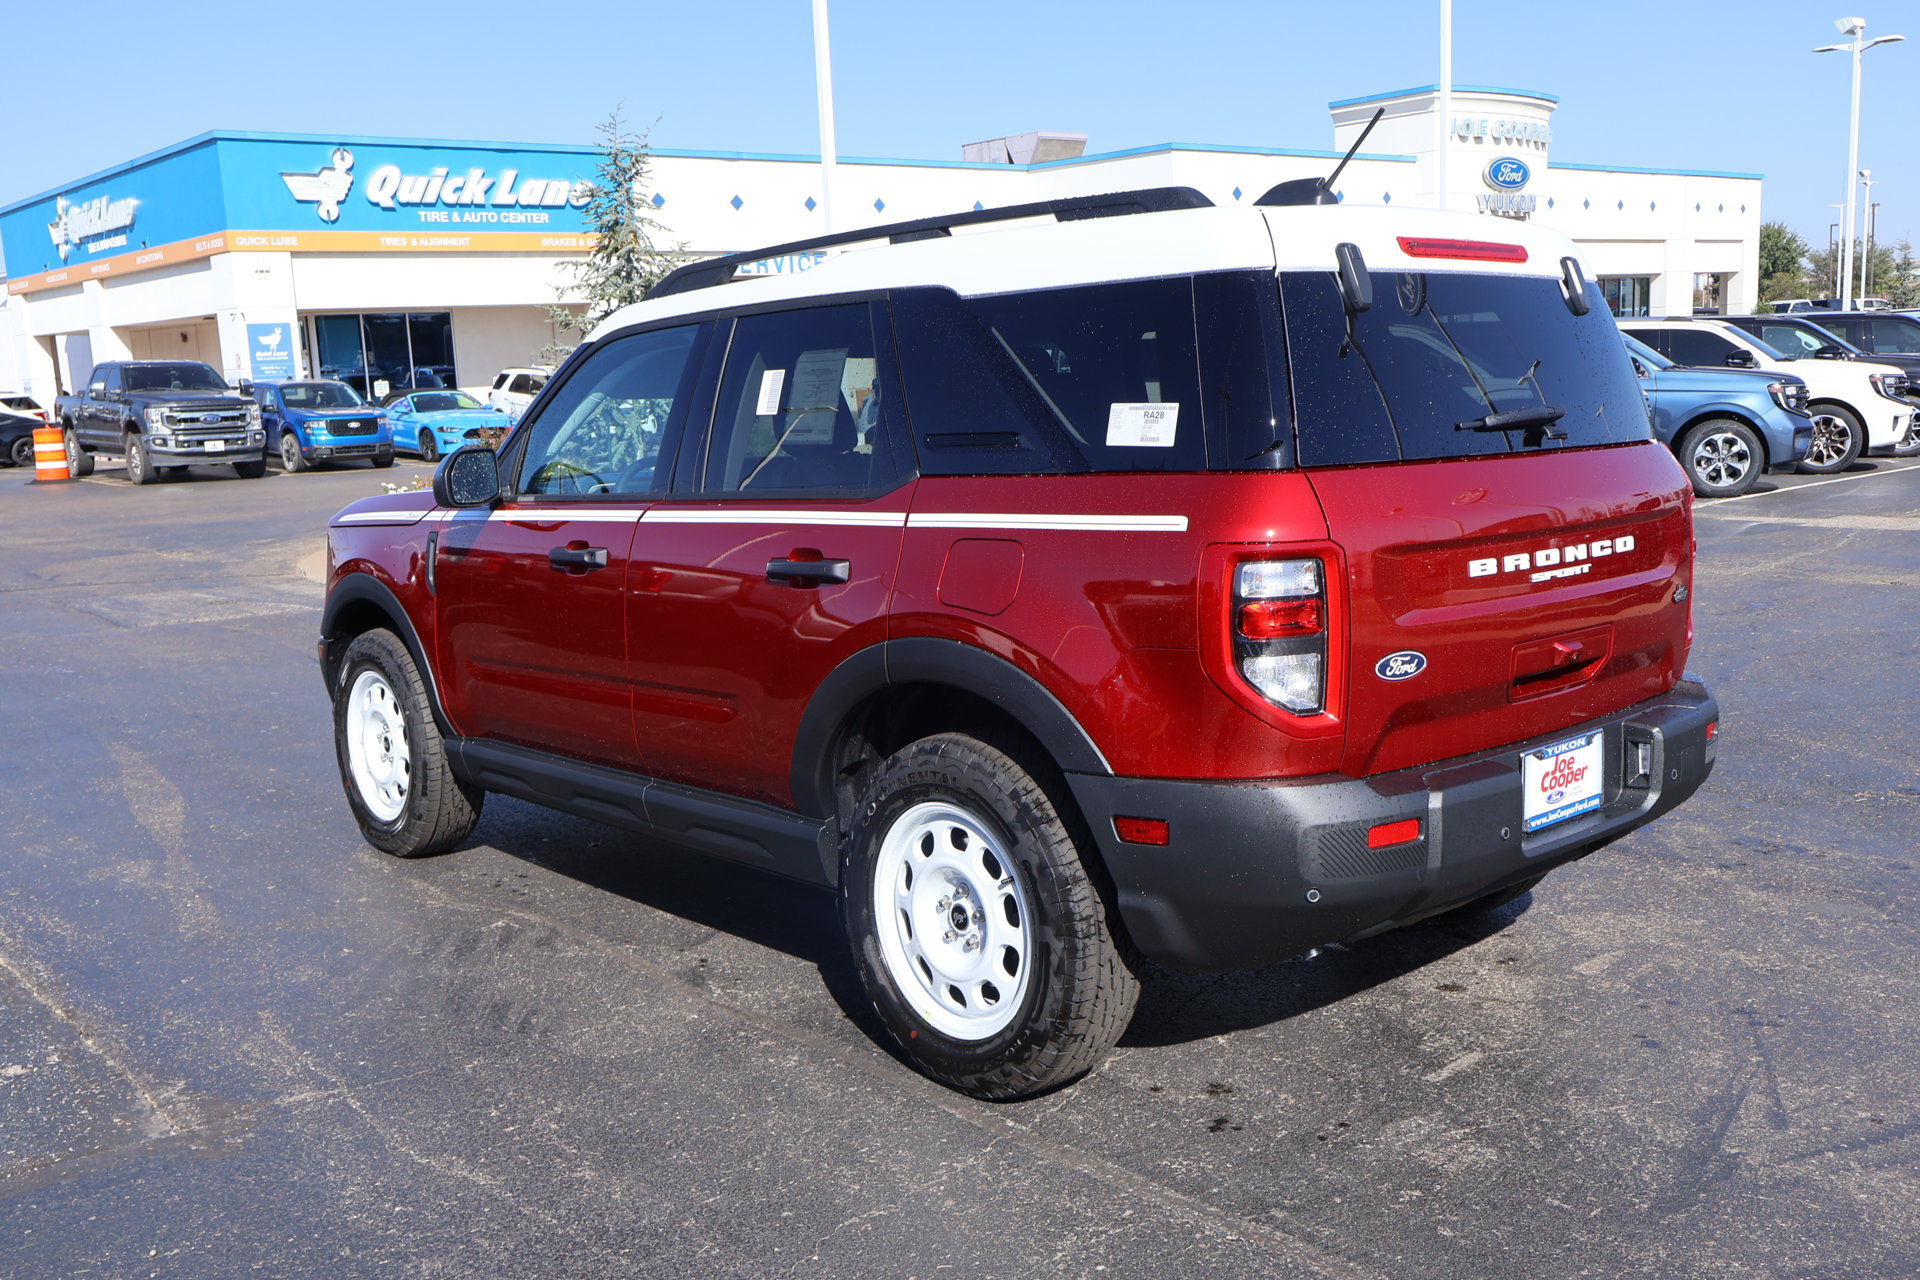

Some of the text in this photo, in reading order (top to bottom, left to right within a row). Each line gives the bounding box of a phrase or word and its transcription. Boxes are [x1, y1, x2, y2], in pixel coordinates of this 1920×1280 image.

[1450, 118, 1488, 137] JOE
[1498, 162, 1524, 182] Ford
[366, 164, 595, 208] Quick Lane
[1483, 194, 1537, 212] YUKON
[418, 211, 549, 224] TIRE & AUTO CENTER
[235, 236, 298, 246] QUICK LUBE
[380, 237, 471, 246] TIRES & ALIGNMENT
[541, 238, 576, 246] BRAKES
[579, 238, 585, 246] &
[727, 252, 826, 273] ERVICE
[1143, 411, 1165, 419] RA28
[1467, 535, 1635, 578] BRONCO
[1530, 563, 1592, 583] SPORT
[1386, 656, 1419, 676] Ford
[1547, 737, 1587, 756] YUKON
[1551, 755, 1575, 776] Joe
[1540, 765, 1588, 793] Cooper
[861, 770, 960, 828] COINENTAL
